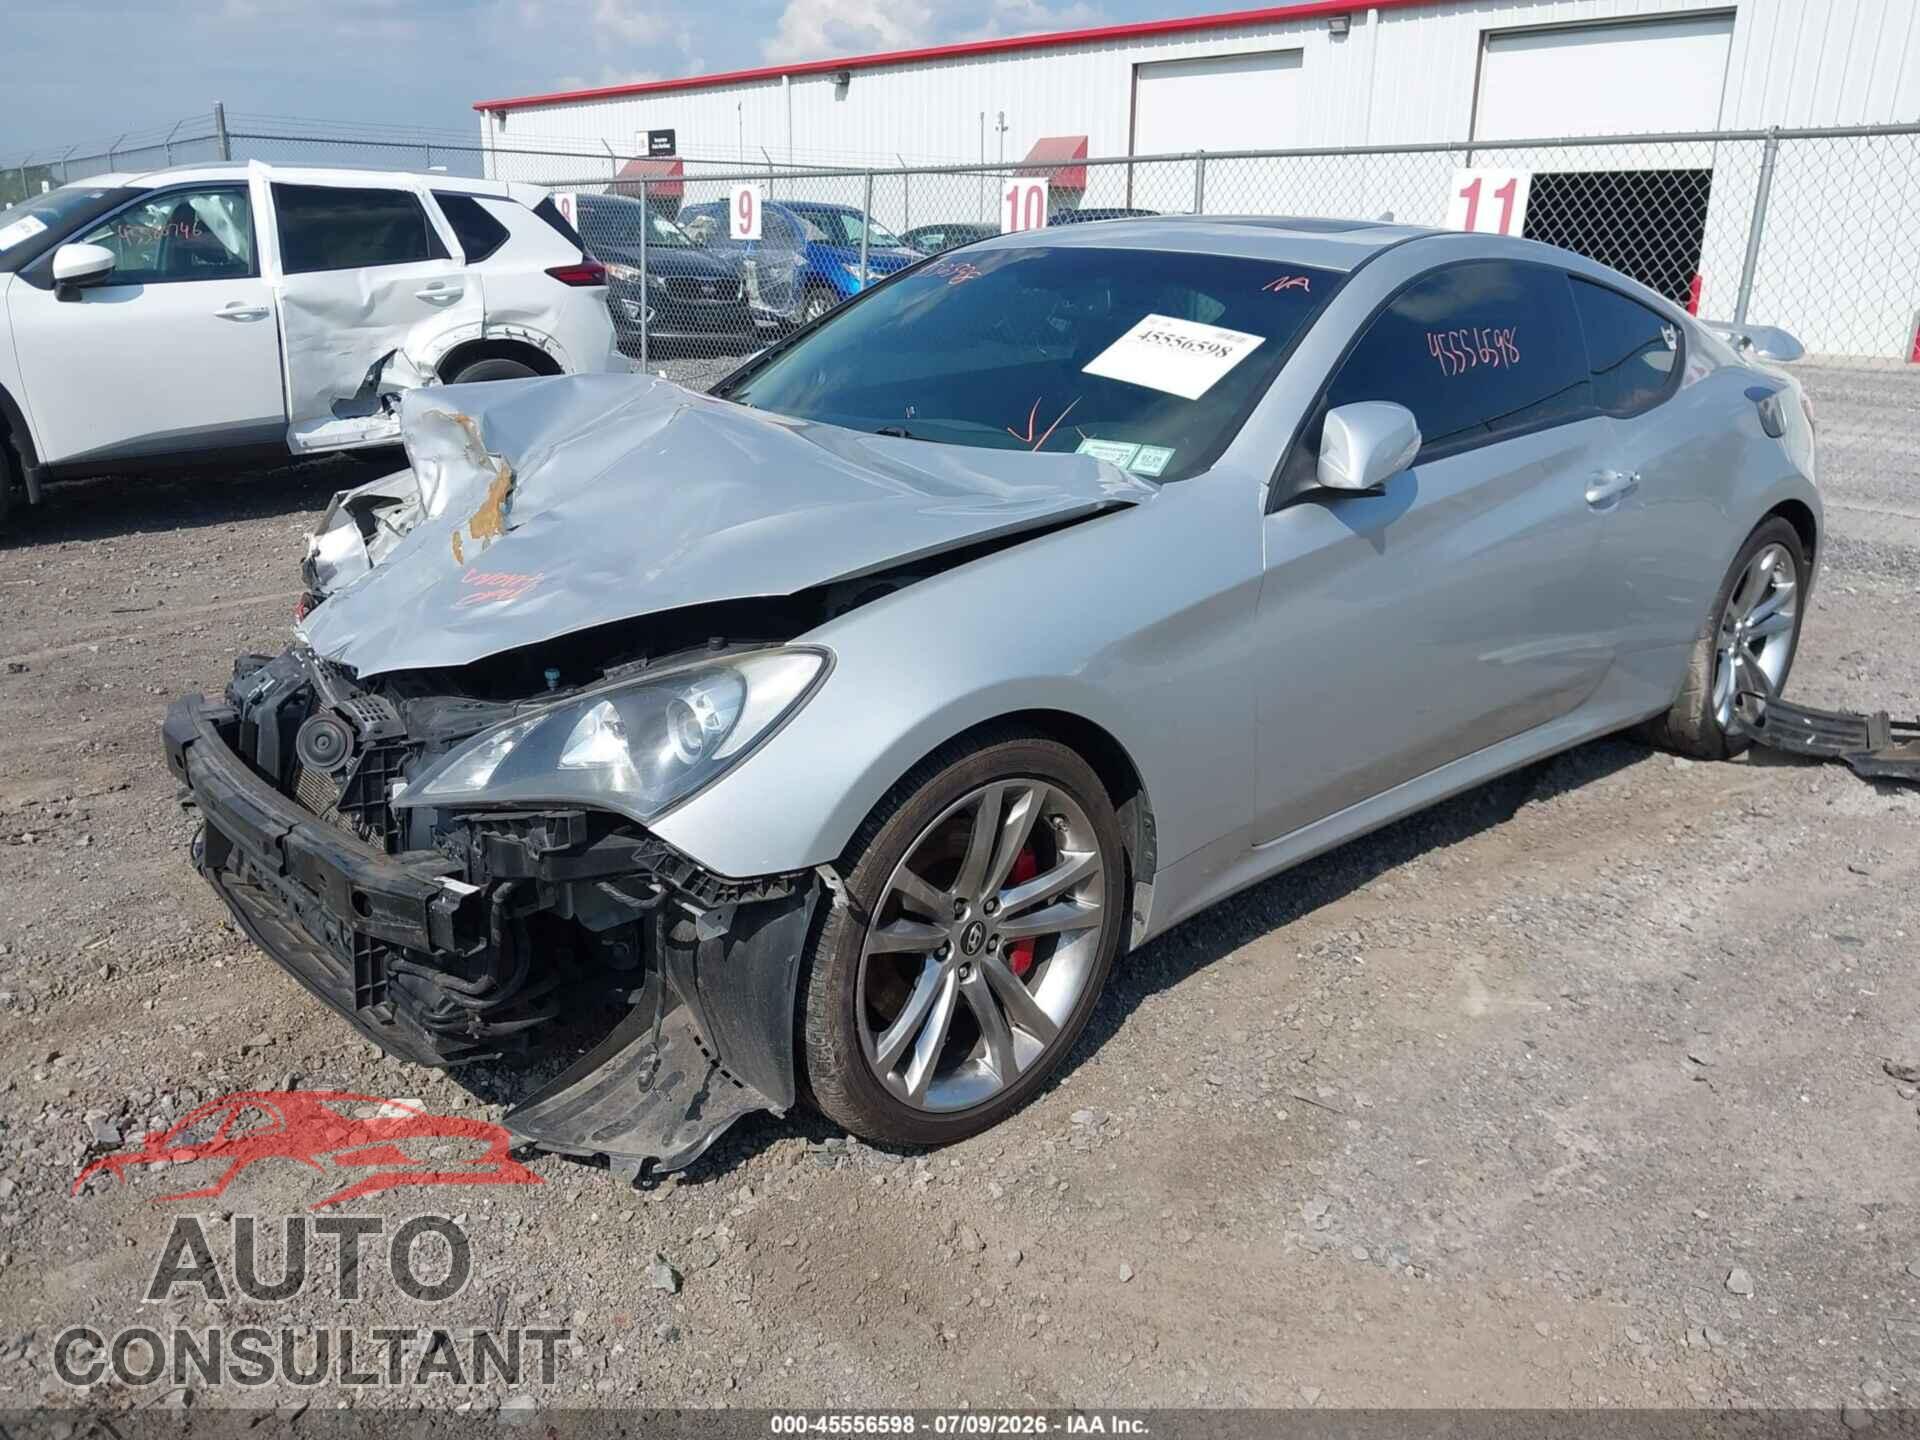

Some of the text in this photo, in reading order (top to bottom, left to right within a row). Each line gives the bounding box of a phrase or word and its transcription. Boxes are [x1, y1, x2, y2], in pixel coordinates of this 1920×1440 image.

[739, 190, 752, 234] 9
[1007, 185, 1043, 232] 10
[1459, 177, 1517, 236] 11
[1137, 330, 1233, 358] 45556598
[1426, 326, 1521, 376] 45556598
